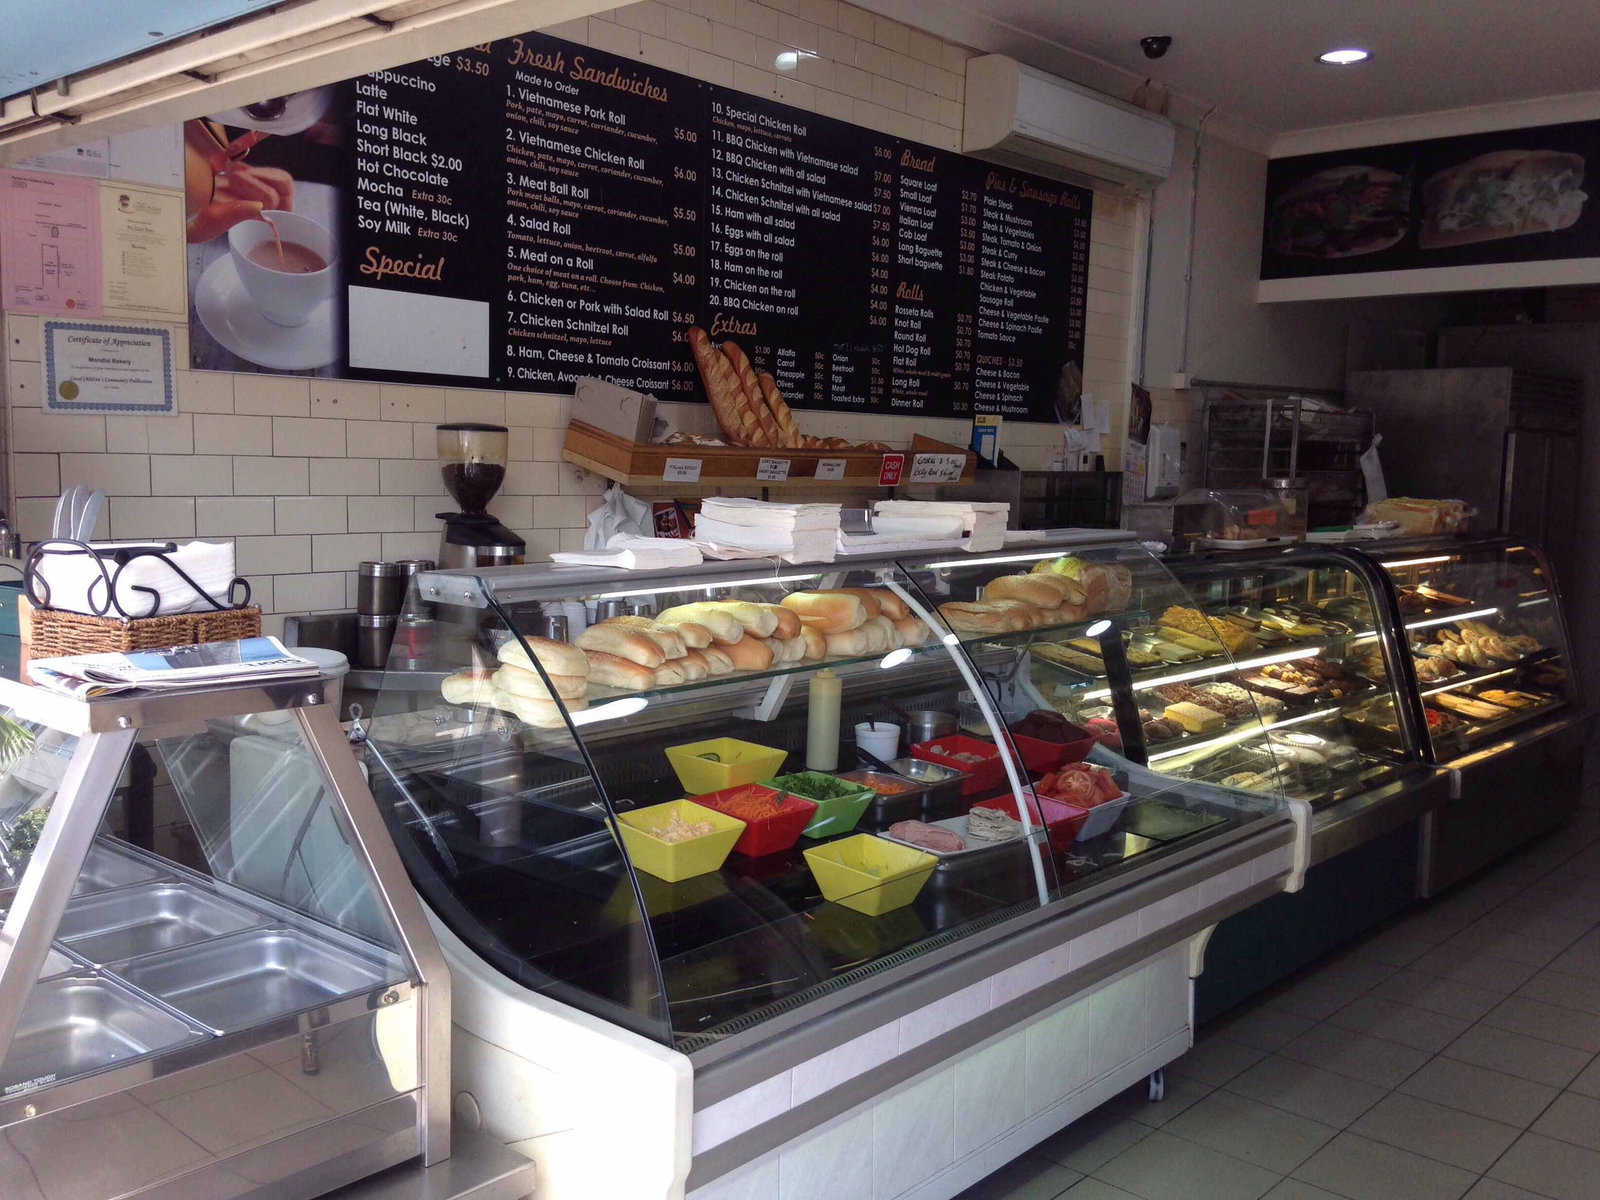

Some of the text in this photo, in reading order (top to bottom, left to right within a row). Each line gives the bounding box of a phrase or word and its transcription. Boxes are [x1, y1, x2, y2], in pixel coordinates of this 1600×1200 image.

[456, 56, 490, 77] $3.50
[508, 38, 668, 102] Fresh Sandwiches
[356, 81, 387, 98] Latte
[516, 70, 579, 95] Made to Order
[357, 100, 417, 124] Flat White
[507, 85, 697, 142] 1. Vietnamese Pork Roll $5.00
[357, 120, 426, 146] Long Black
[712, 102, 892, 159] 10. Special Chicken Roll $5.00
[357, 139, 462, 171] Short Black $2.00
[506, 128, 696, 181] 2. Vietnamese Chicken Roll $6.00
[713, 130, 891, 183] 11. BBQ Chicken with Vietnamese salad $7.00
[900, 149, 935, 173] Bread
[358, 158, 448, 186] Hot Chocolate
[901, 175, 937, 191] Square Loaf
[358, 177, 452, 205] Mocha Extra 30c
[507, 172, 696, 221] 3. Meat Ball Roll $5.50
[712, 167, 872, 212] 13. Chicken Schnitzel with Vietnamese salad
[358, 196, 469, 229] Tea (White, Black)
[900, 202, 936, 217] Vienna Loaf
[984, 208, 998, 219] Steak
[1005, 214, 1032, 226] Mushroom
[358, 215, 457, 242] Soy Milk Extra 30c
[507, 214, 695, 256] 4. Salad Roll $5.00
[899, 242, 942, 257] Long Baguette
[360, 246, 444, 280] Special
[508, 246, 695, 285] 5. Meat on a Roll $4.00
[711, 277, 795, 298] 19. Chicken on the roll
[896, 281, 924, 301] Rolls
[508, 290, 694, 324] 6. Chicken or Pork with Salad Roll $6.50
[710, 295, 798, 315] 20. BBQ Chicken on roll
[895, 305, 933, 318] Rosseta Rolls
[980, 294, 1013, 306] Sausage Roll
[508, 312, 628, 335] 7. Chicken Schnitzel Roll
[711, 313, 757, 336] Extras
[68, 336, 152, 348] Certificate of Appreciation
[978, 330, 1016, 342] Tomato Sauce
[507, 345, 693, 372] 8. Ham, Cheese & Tomato Croissant $6.00
[833, 354, 848, 362] Onion
[894, 344, 904, 352] Hot
[906, 345, 918, 356] Dog
[920, 346, 930, 355] Roll
[508, 367, 514, 378] 9.
[518, 368, 555, 382] Chicken,
[636, 378, 669, 389] Croissant
[672, 380, 693, 390] $6.00
[777, 369, 804, 379] Pineapple
[832, 364, 854, 372] Beetroot
[892, 398, 923, 408] Dinner Roll
[883, 472, 897, 480] ONLY
[885, 461, 900, 470] CASH
